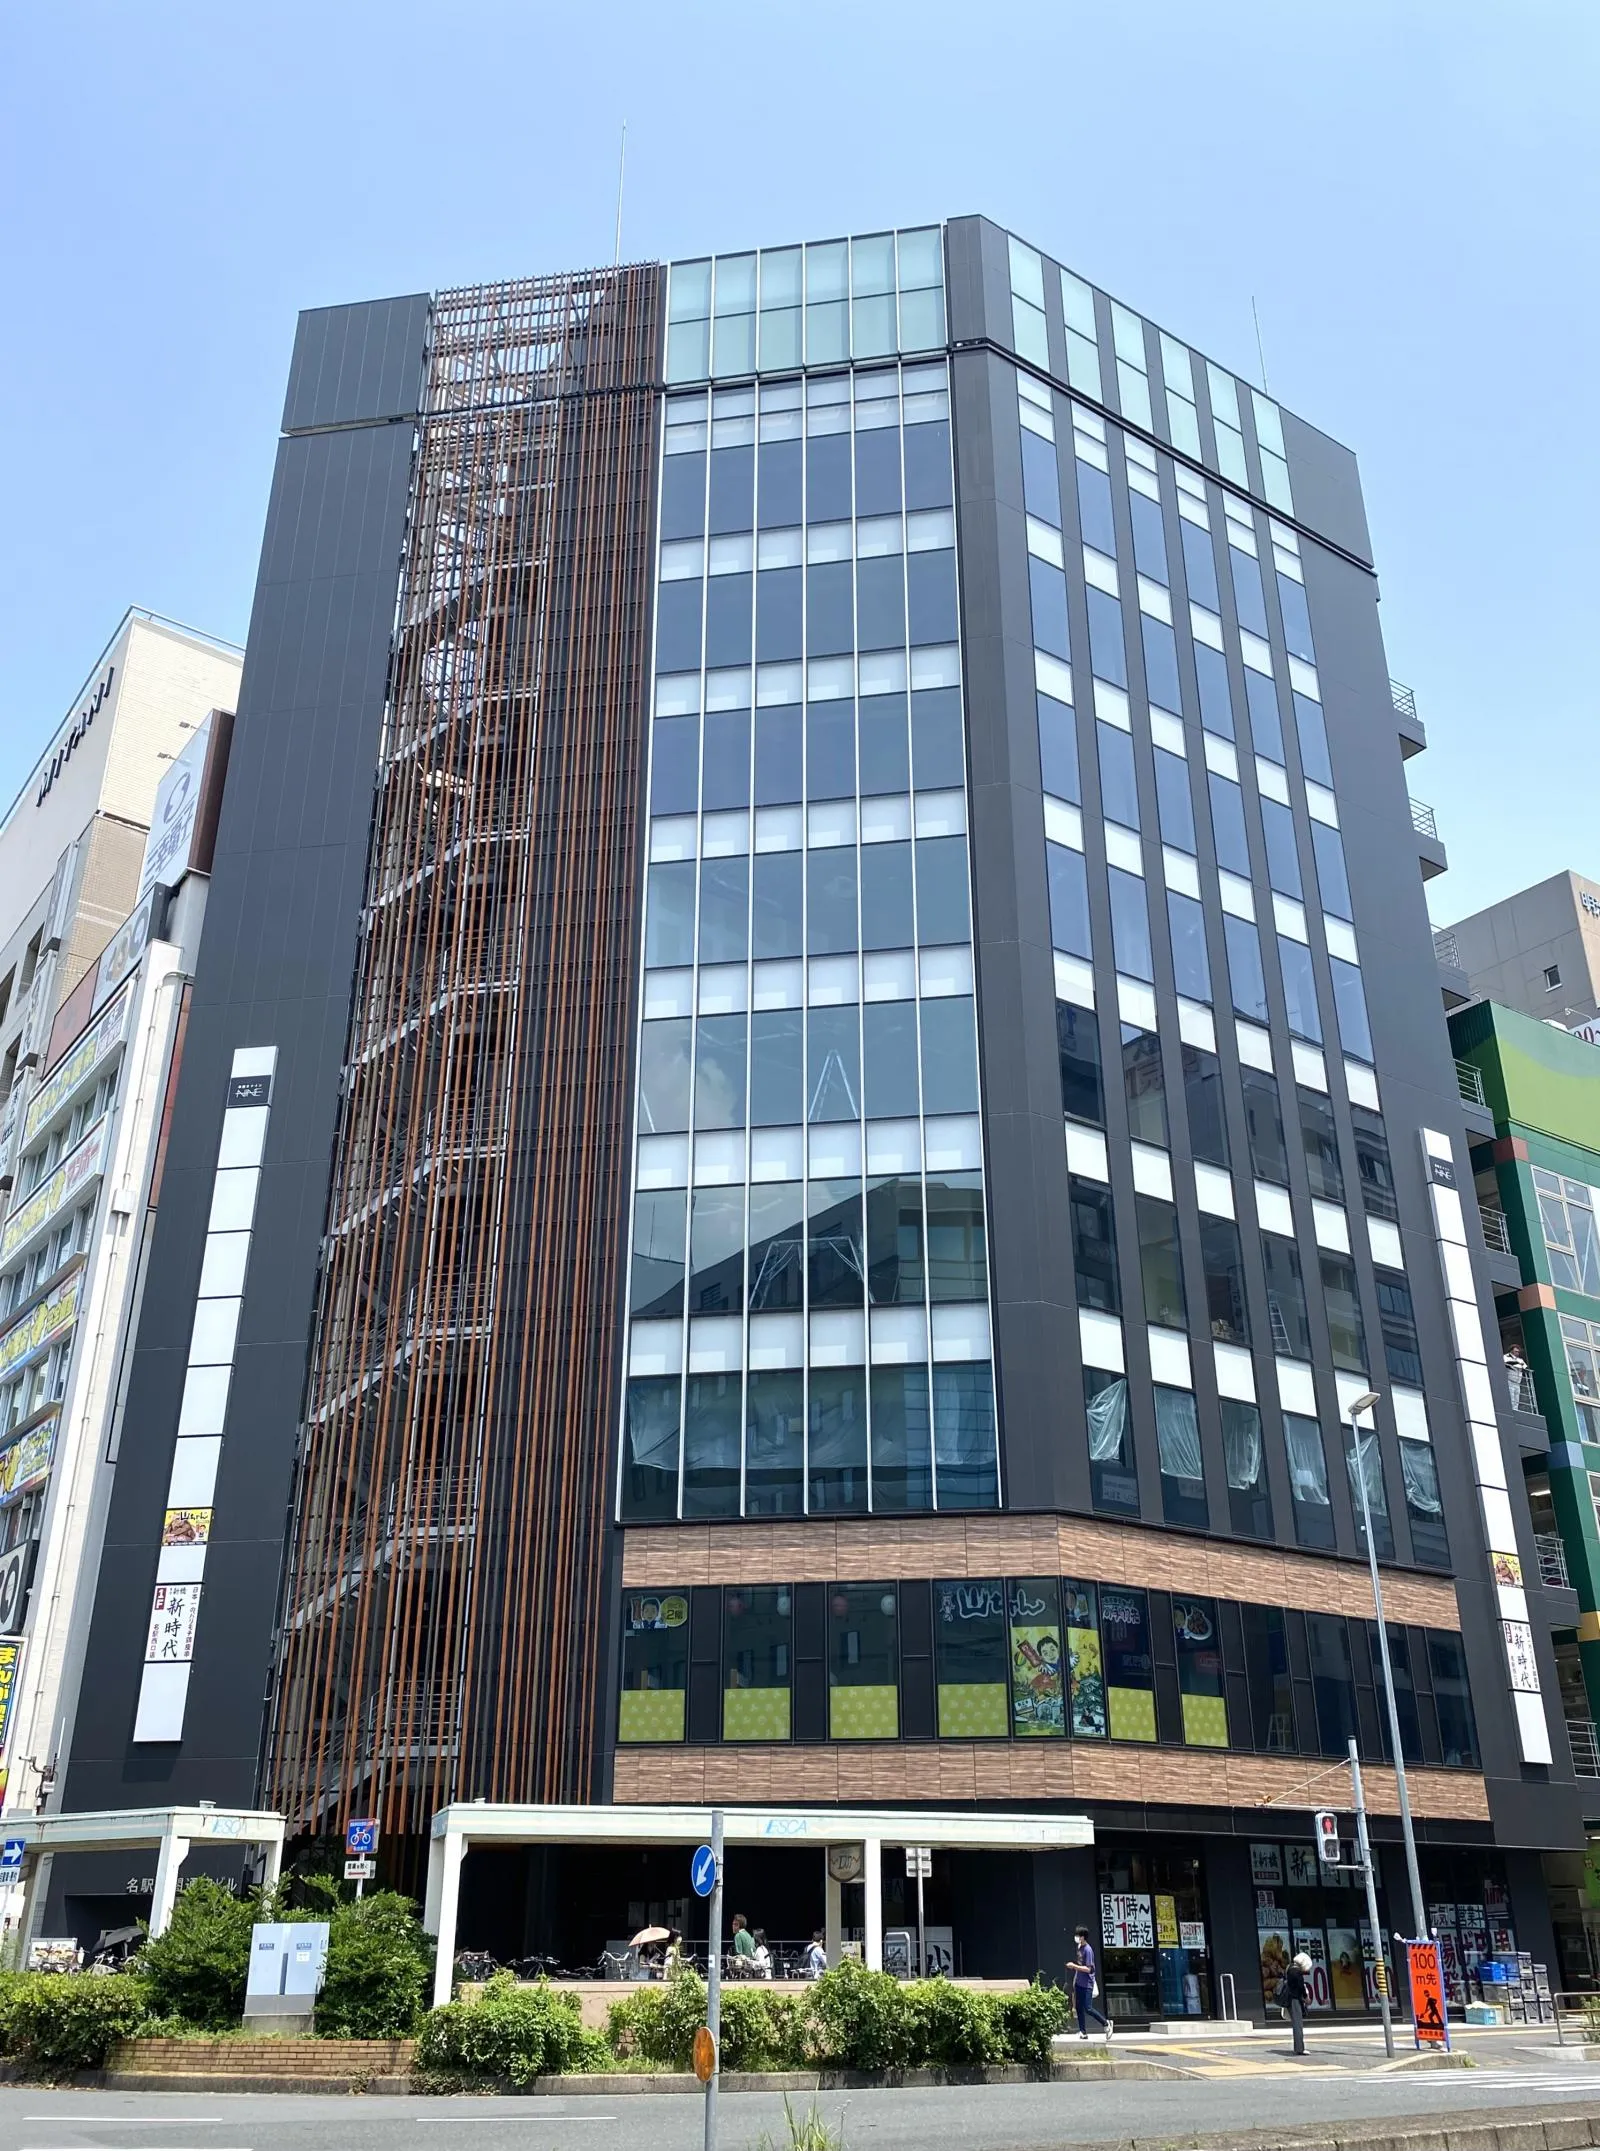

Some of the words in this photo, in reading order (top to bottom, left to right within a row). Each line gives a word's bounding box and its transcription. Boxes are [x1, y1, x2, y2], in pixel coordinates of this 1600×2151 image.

[161, 1597, 185, 1658] 新時代
[1514, 1633, 1532, 1689] 新時代
[765, 1819, 808, 1834] ESCA
[1104, 1921, 1153, 1947] 翌1時迄
[1412, 1953, 1436, 1969] 100
[1416, 1974, 1437, 1985] m先
